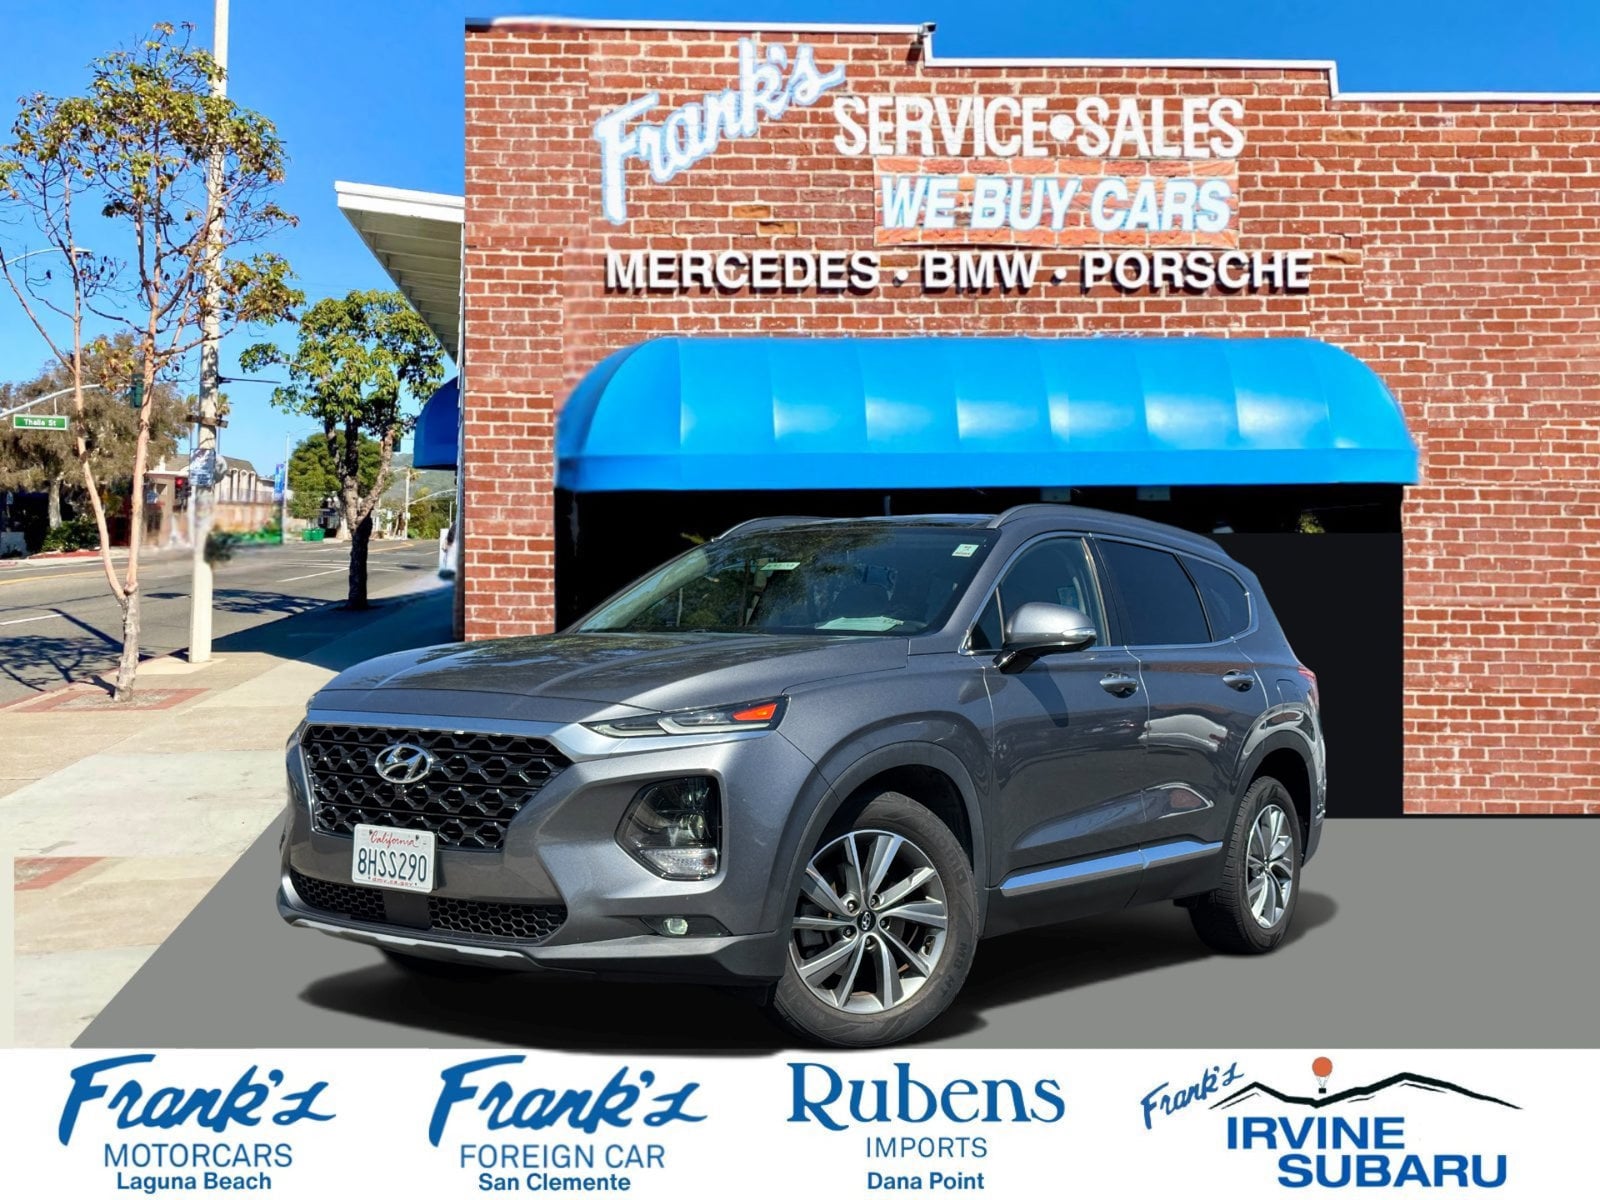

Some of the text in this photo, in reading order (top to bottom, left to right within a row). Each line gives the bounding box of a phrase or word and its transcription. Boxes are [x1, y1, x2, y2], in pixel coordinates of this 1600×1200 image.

[593, 38, 846, 226] Frank's
[833, 96, 1245, 158] SERVICE SALES
[880, 174, 1233, 233] WE BUY CARS
[605, 250, 1313, 293] MERCEDES BMW PORSCHE
[358, 847, 427, 882] 8HSS290
[370, 830, 419, 848] California
